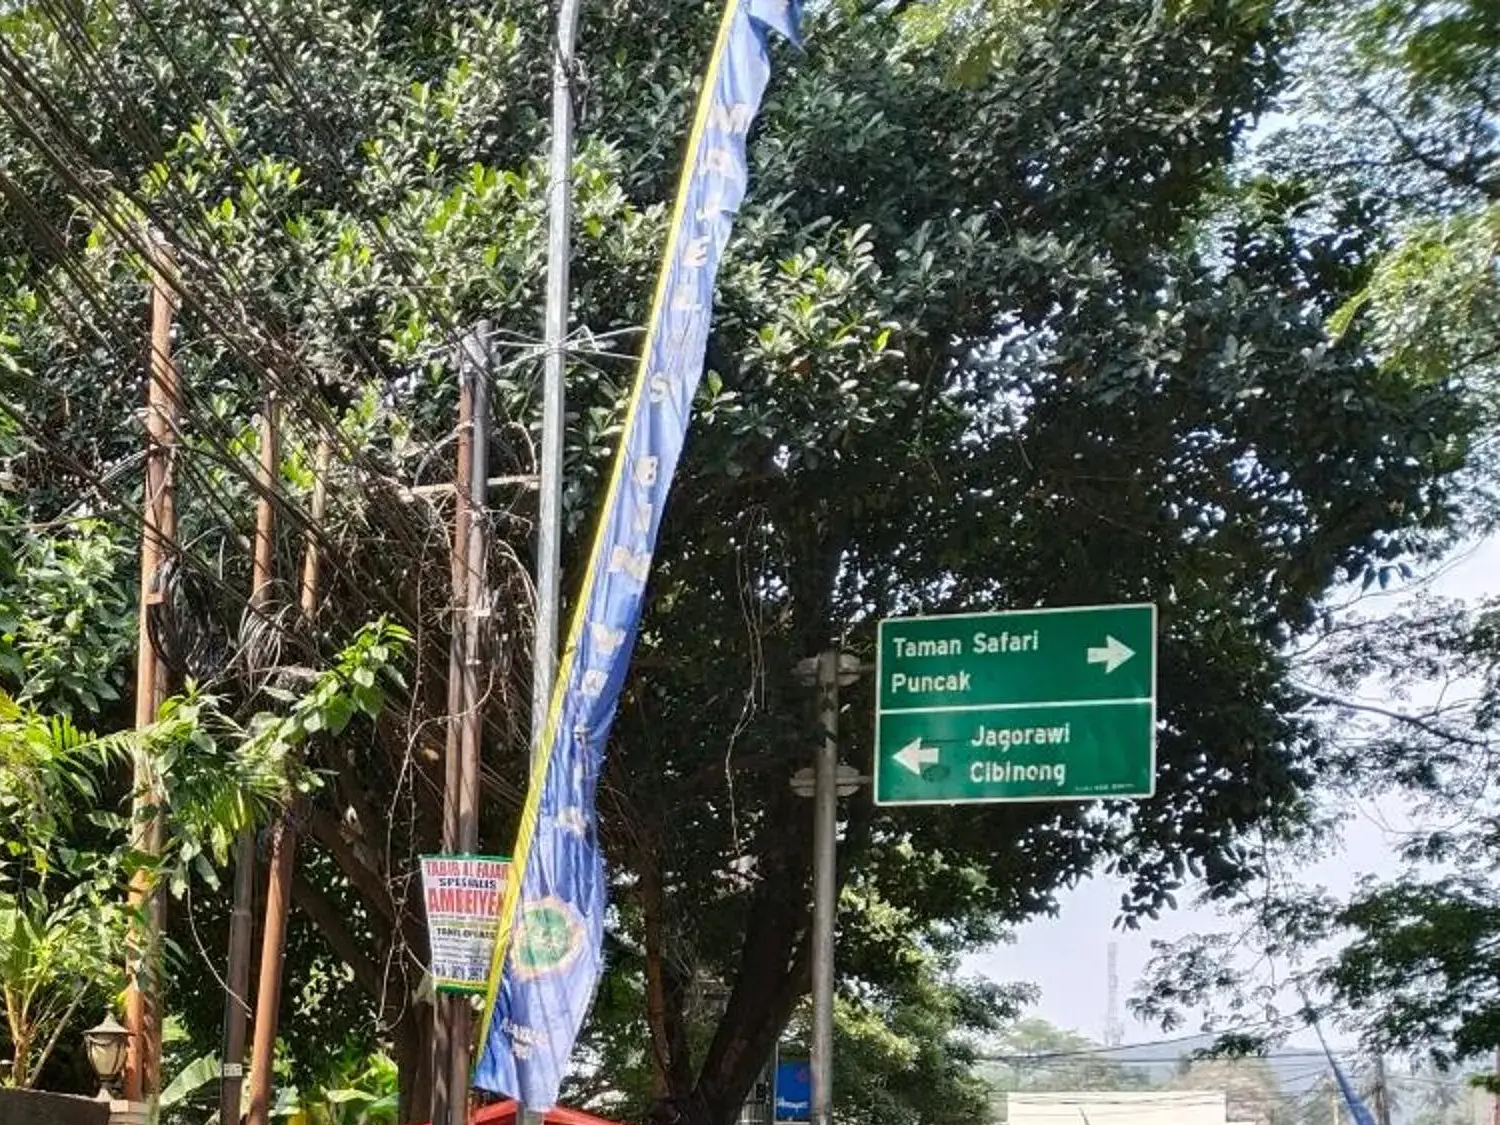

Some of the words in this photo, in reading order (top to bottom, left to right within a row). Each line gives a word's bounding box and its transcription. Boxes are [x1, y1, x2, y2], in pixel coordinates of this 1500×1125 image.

[892, 637, 962, 658] Taman
[972, 630, 1040, 654] Safari
[891, 670, 972, 694] Puncak
[971, 722, 1071, 752] Jagorawi
[970, 761, 1066, 786] Cibinong
